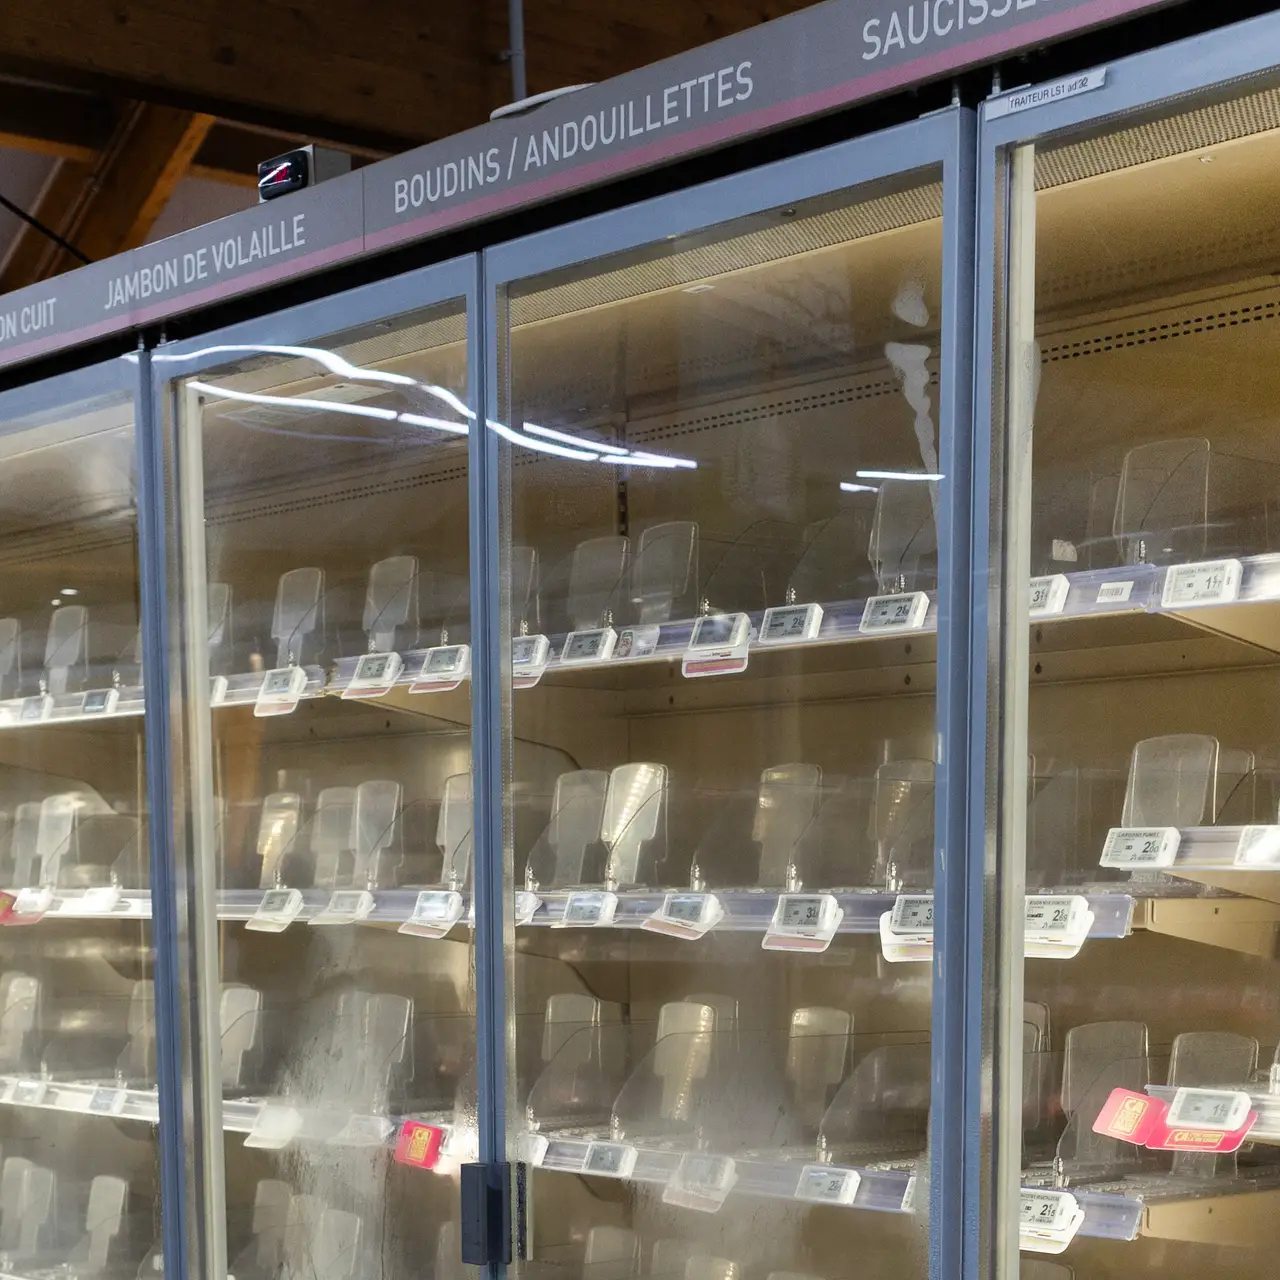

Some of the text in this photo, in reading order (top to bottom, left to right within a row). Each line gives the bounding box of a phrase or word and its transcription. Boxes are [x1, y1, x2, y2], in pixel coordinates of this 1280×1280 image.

[1010, 90, 1049, 109] TRAITEUR
[394, 60, 754, 213] BOUDINS / ANDOUILLETTES
[104, 213, 306, 311] JAMBON DE VOLAILLE
[20, 298, 57, 336] CUIT
